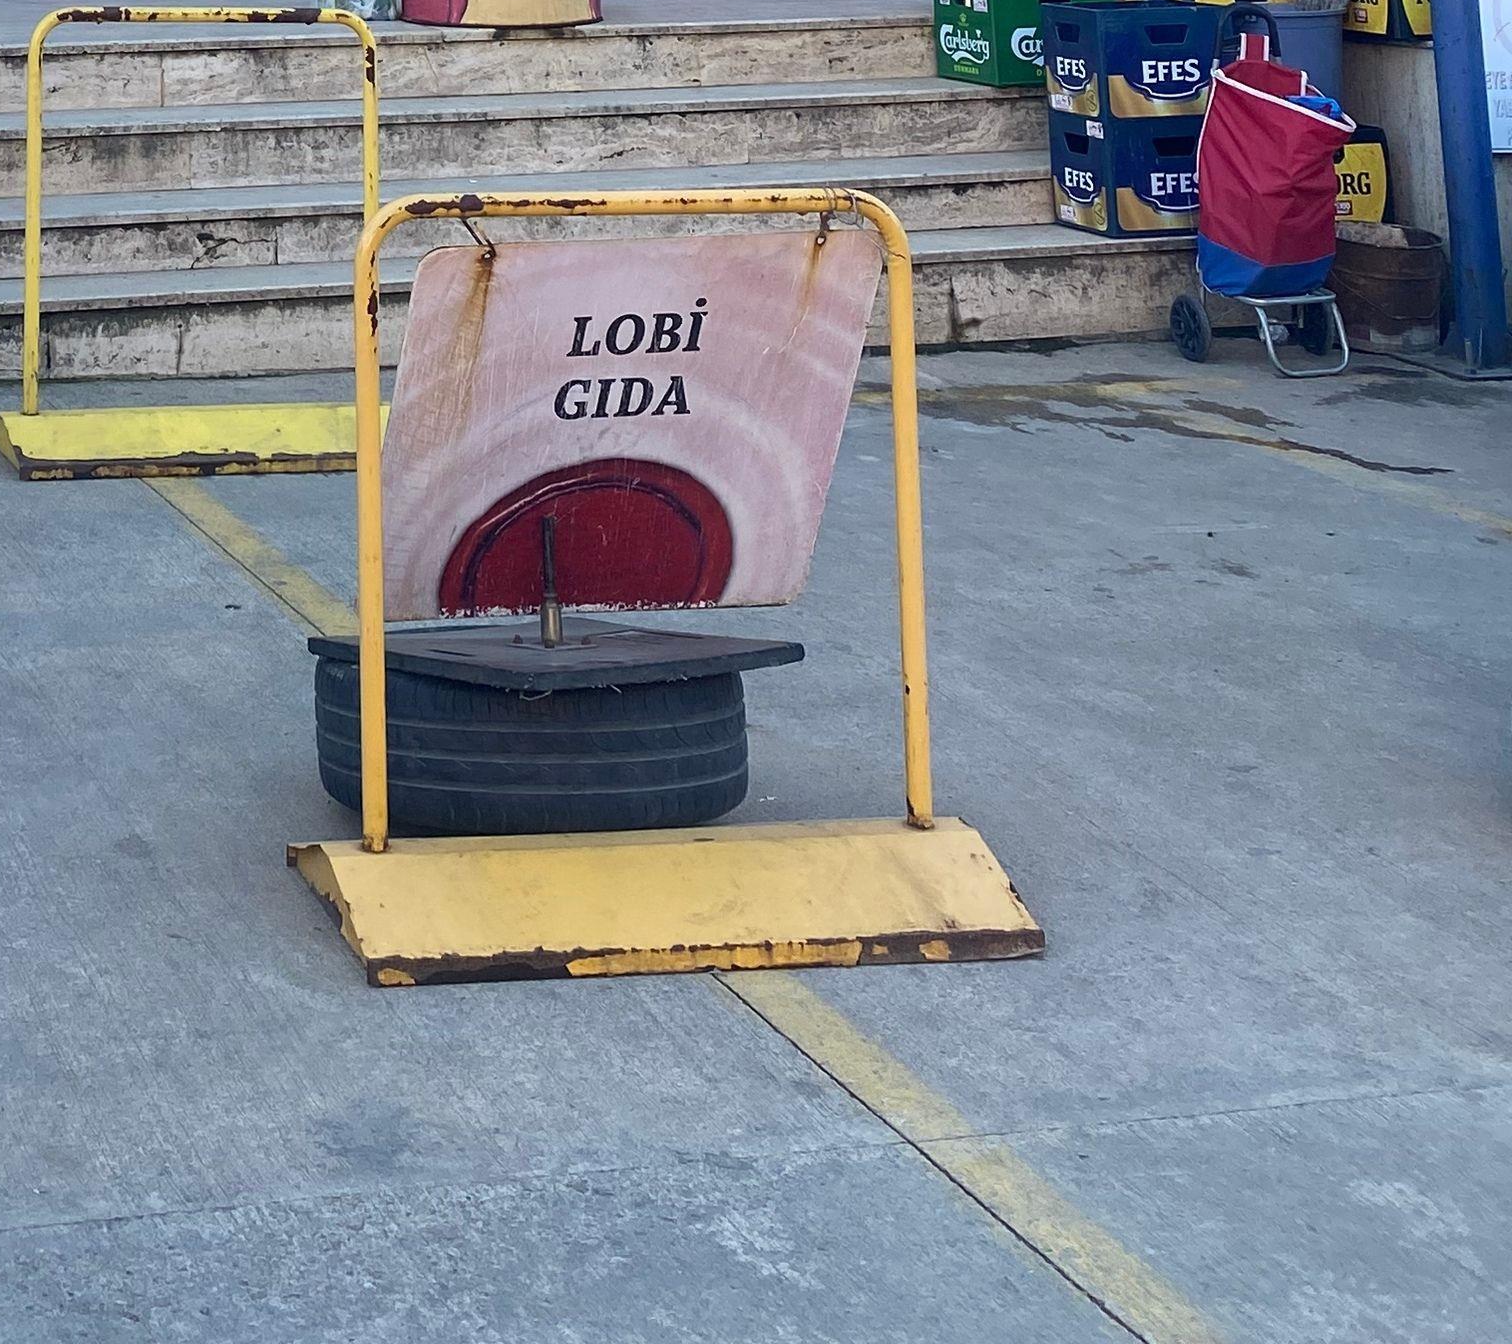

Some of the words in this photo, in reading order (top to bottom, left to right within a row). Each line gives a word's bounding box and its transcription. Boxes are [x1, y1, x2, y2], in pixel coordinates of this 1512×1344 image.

[940, 24, 990, 64] Carlsberg
[1056, 56, 1086, 79] EFES
[1141, 59, 1201, 84] EFES
[1064, 166, 1094, 192] EFES
[554, 375, 691, 420] GIDA
